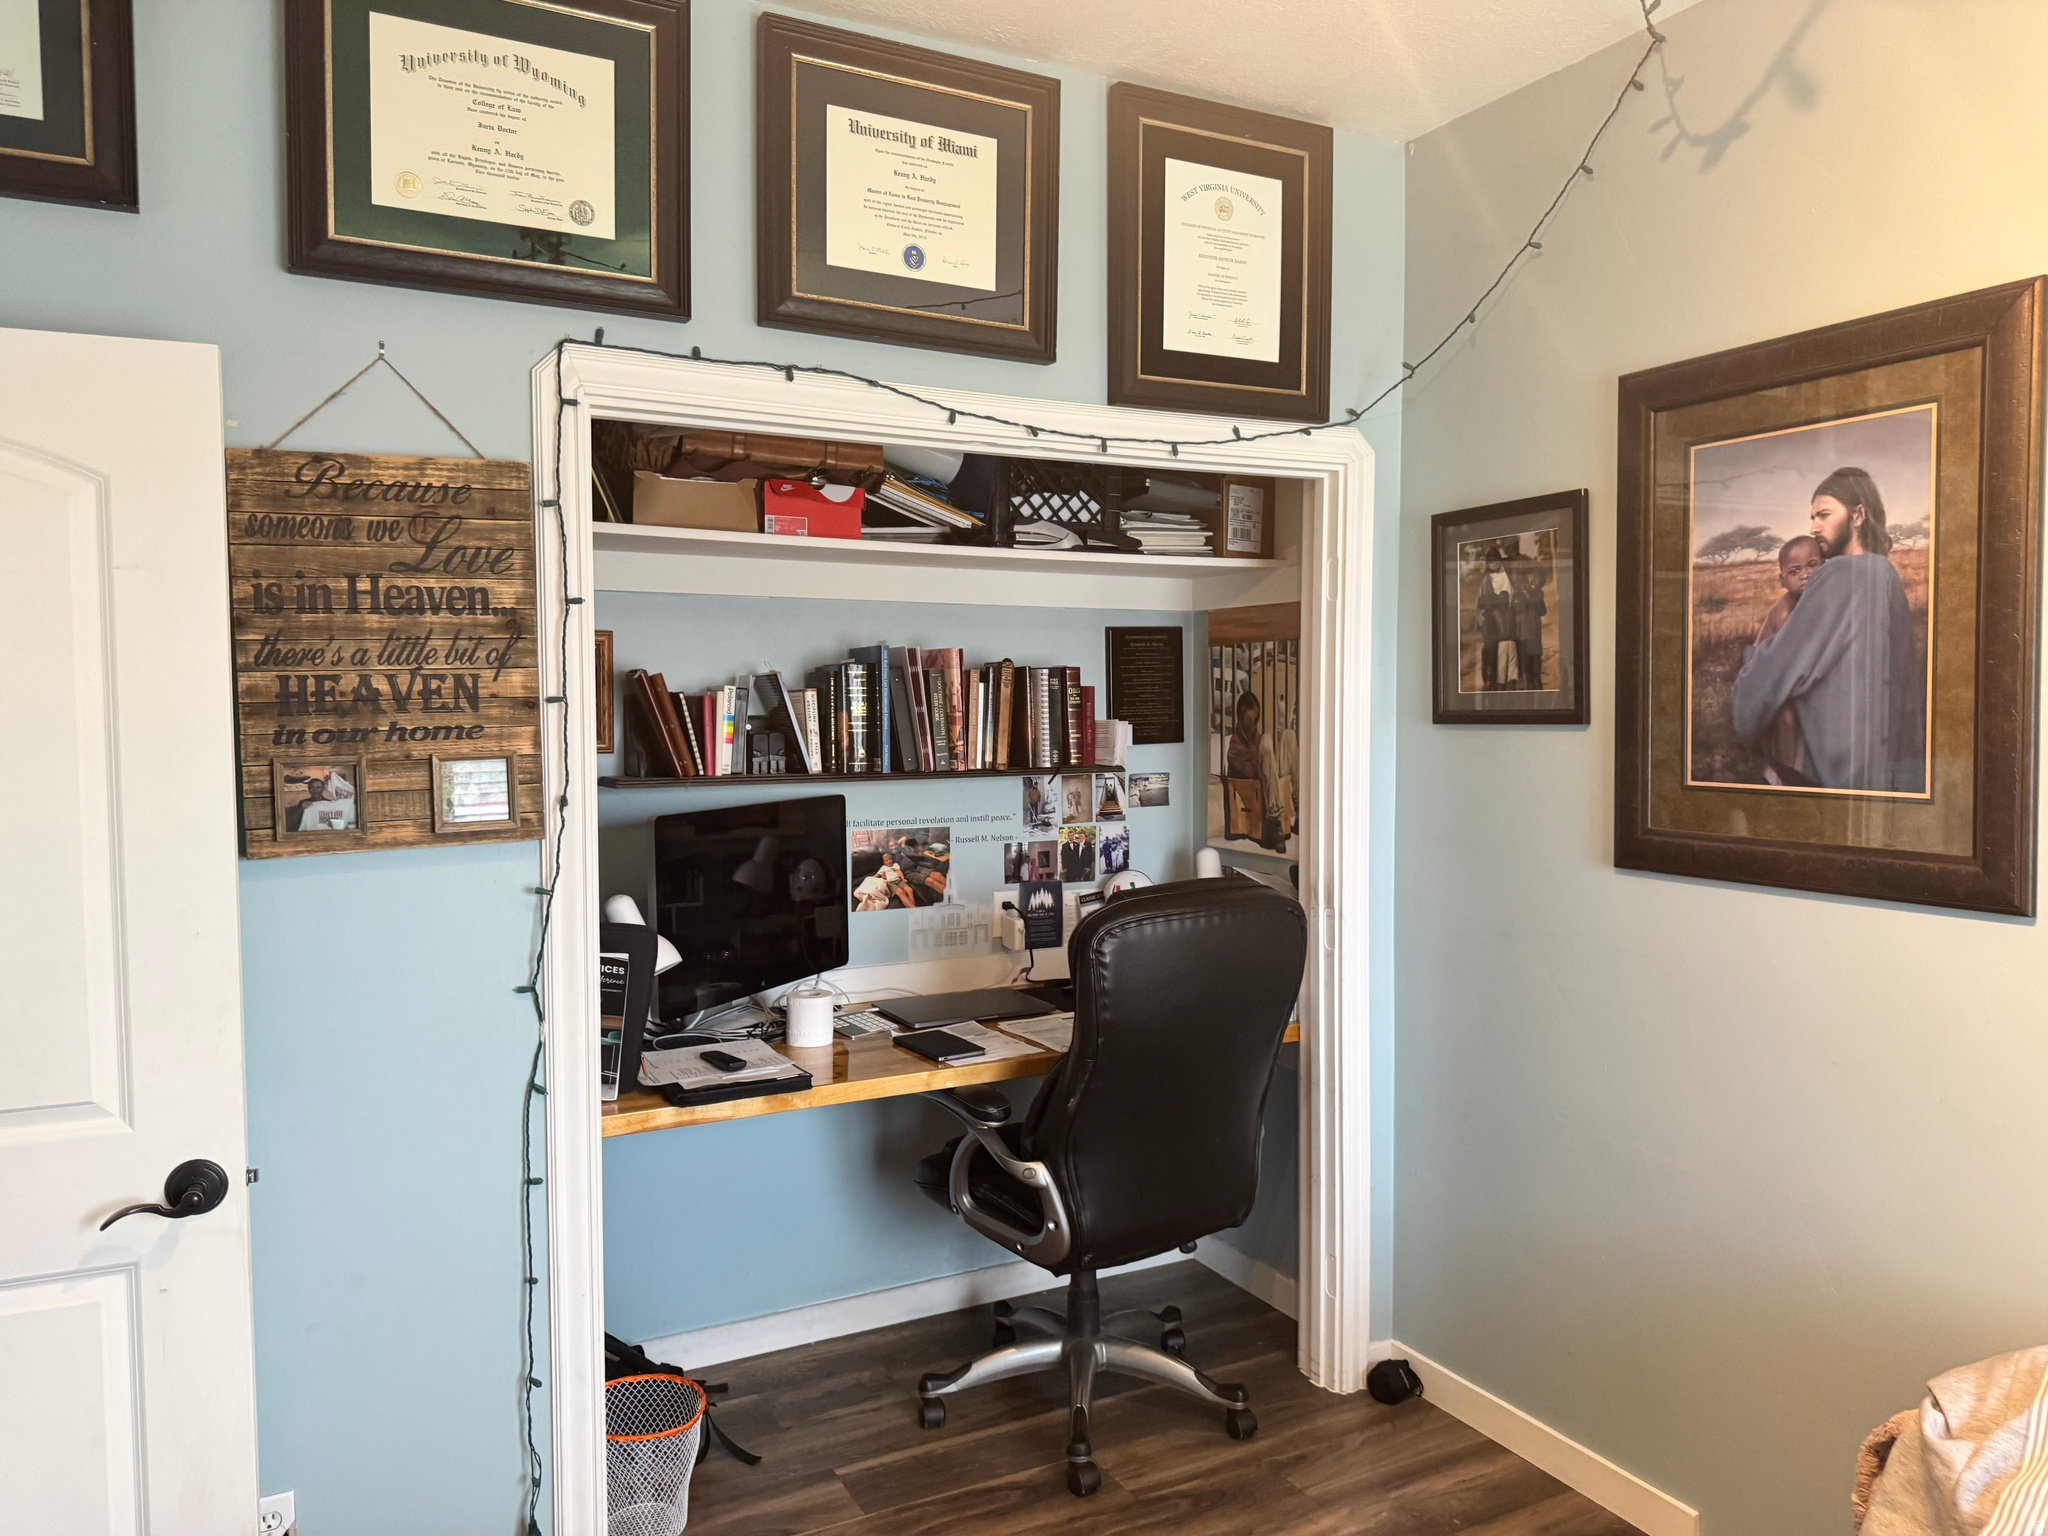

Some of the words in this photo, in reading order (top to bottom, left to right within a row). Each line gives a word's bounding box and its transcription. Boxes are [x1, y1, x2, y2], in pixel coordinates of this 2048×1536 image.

[399, 49, 489, 73] University
[493, 54, 509, 67] of
[513, 54, 587, 109] Wyoming
[472, 99, 496, 109] College
[507, 105, 522, 113] Law
[478, 121, 495, 130] Juris
[498, 125, 517, 134] Doctor
[848, 118, 916, 149] University
[920, 135, 935, 149] of
[938, 136, 978, 158] Miami
[472, 144, 491, 155] Kenny
[505, 150, 524, 160] Hardy
[1181, 187, 1198, 201] WEST
[1199, 184, 1228, 192] VIRGINIA
[1231, 186, 1265, 216] UNIVERSITY
[284, 457, 472, 504] Because
[367, 519, 403, 542] we
[389, 511, 515, 574] Love
[250, 570, 283, 614] is
[294, 570, 335, 615] in
[344, 573, 517, 617] Heaven...
[254, 629, 343, 667] there's
[351, 645, 369, 666] a
[377, 628, 439, 666] little
[444, 630, 481, 665] bit
[486, 629, 522, 682] of
[275, 666, 481, 716] HEAVEN
[272, 724, 306, 746] in
[312, 724, 380, 744] our
[384, 722, 484, 742] home
[886, 817, 917, 828] personal
[955, 835, 980, 843] Russell
[600, 964, 625, 974] ICES
